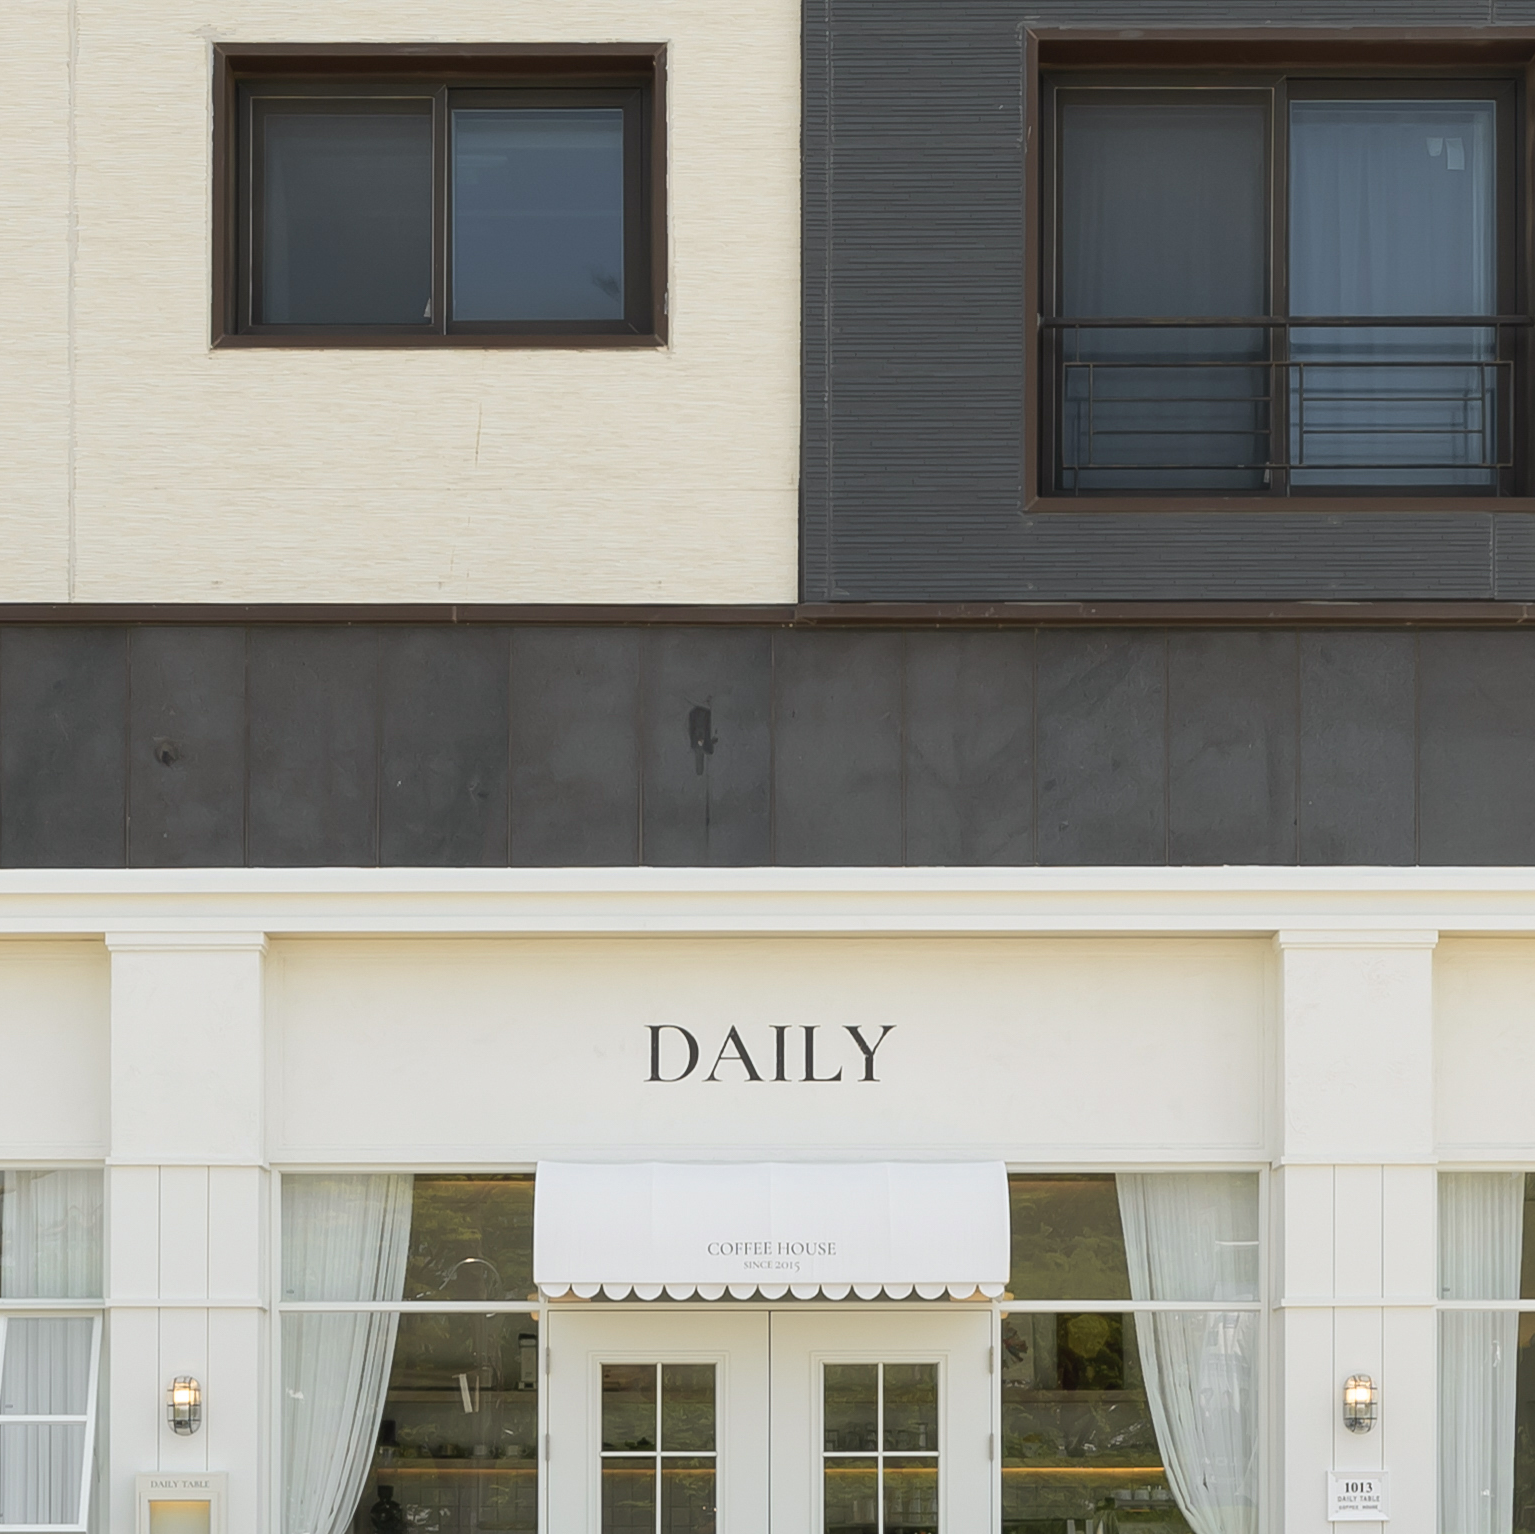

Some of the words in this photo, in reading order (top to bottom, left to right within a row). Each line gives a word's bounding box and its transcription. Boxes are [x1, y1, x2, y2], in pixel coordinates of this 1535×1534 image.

[644, 1024, 897, 1082] DAILY
[707, 1242, 772, 1256] COFFEE
[777, 1242, 837, 1256] HOUSE
[743, 1261, 773, 1270] SINCE
[775, 1261, 801, 1273] 2015
[150, 1480, 178, 1489] DAILY
[181, 1480, 210, 1489] TABLE
[1345, 1482, 1373, 1494] 1013
[1337, 1495, 1357, 1503] DAILY
[1360, 1495, 1380, 1503] TABLE
